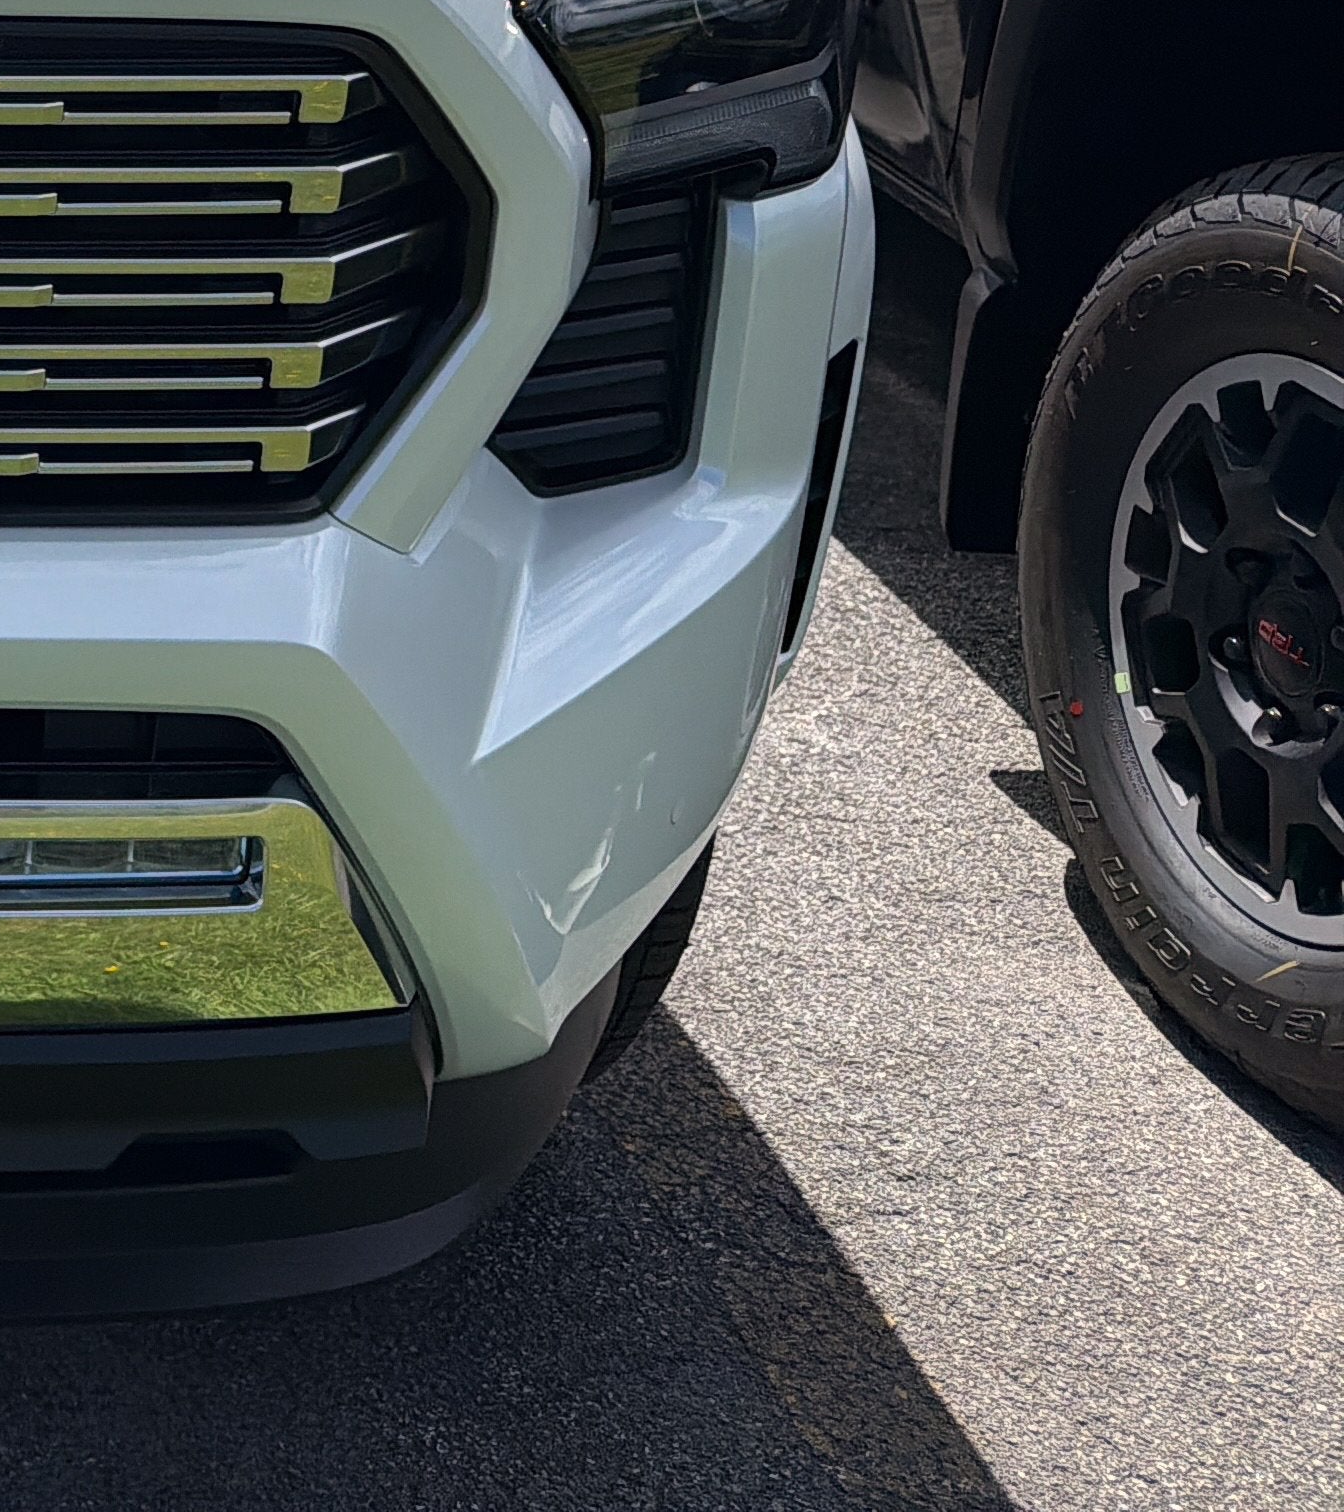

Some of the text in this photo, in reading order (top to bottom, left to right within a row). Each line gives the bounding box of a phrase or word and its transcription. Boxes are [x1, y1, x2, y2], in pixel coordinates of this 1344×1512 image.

[1258, 618, 1311, 668] TRD
[1038, 690, 1344, 1051] errain T/A
